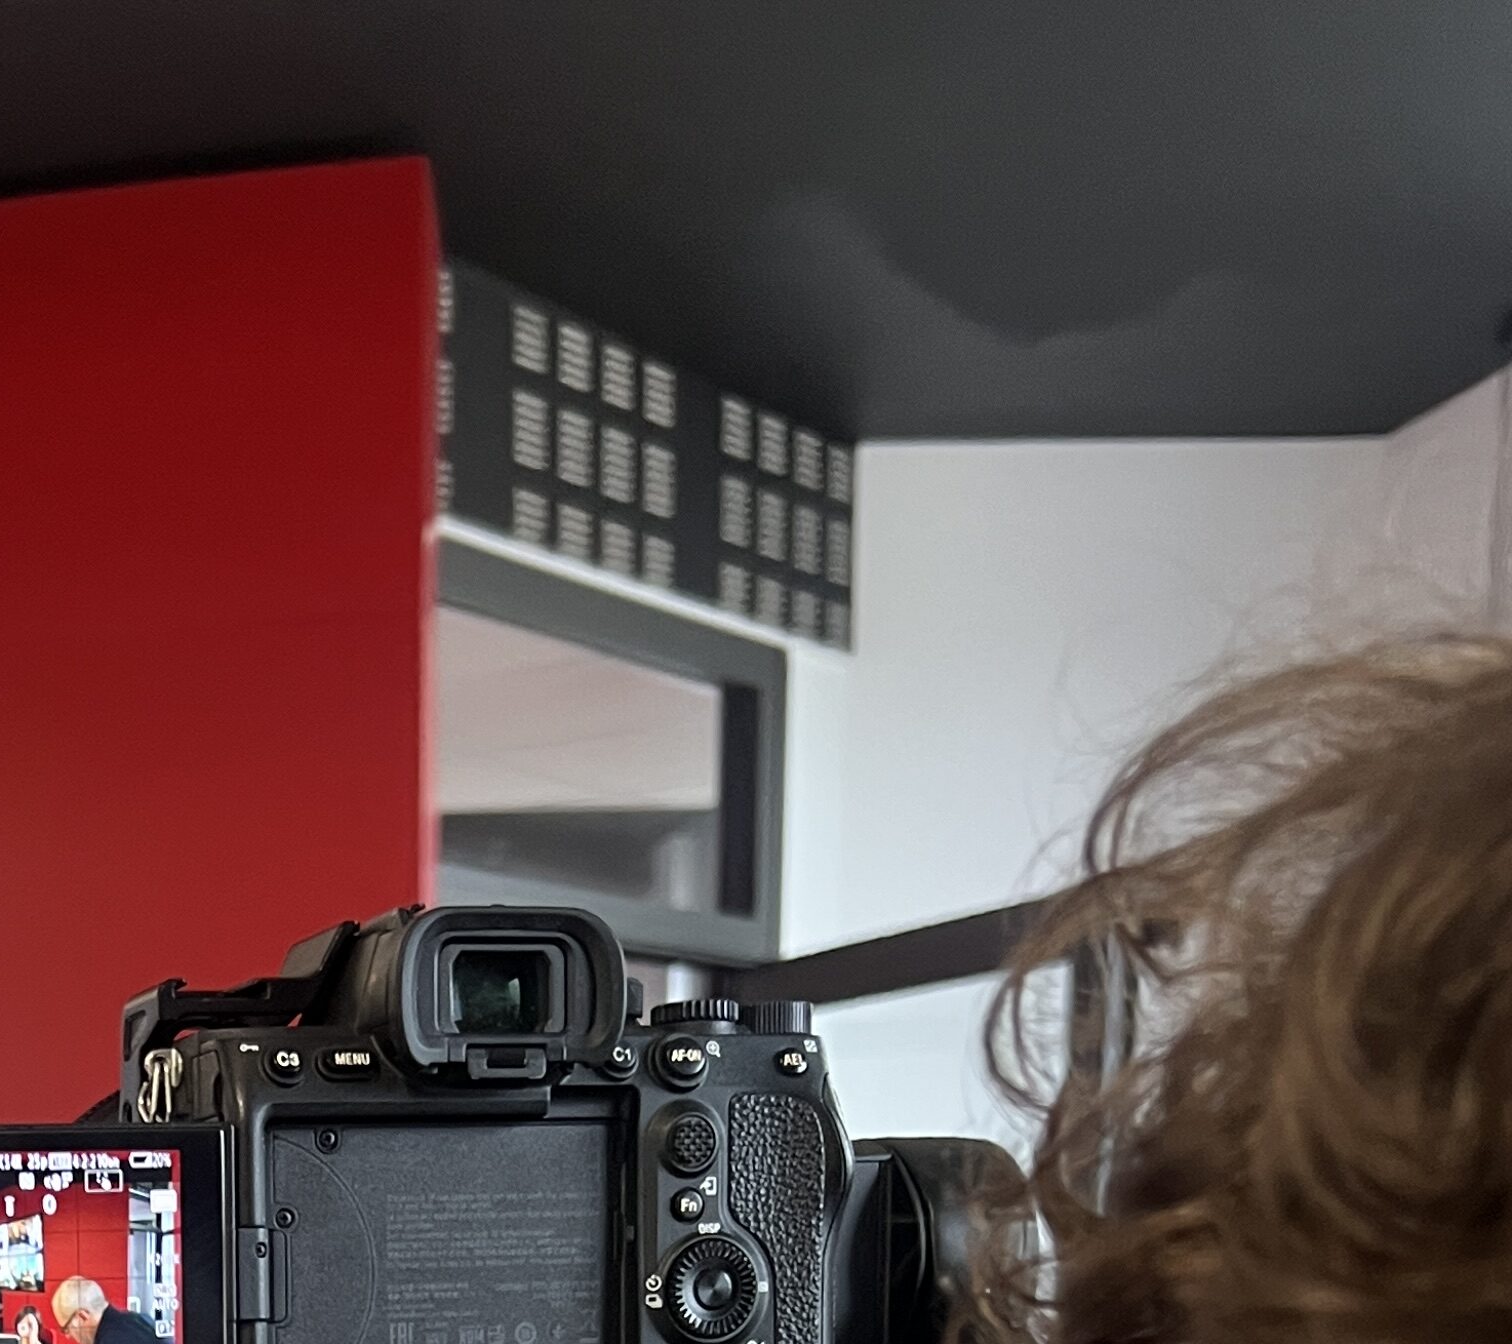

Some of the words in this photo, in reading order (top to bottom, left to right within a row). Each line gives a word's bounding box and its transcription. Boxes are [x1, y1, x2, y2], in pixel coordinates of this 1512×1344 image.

[276, 1050, 301, 1068] C3
[334, 1052, 371, 1066] MENU
[612, 1046, 632, 1062] C1
[680, 1198, 699, 1213] Fn
[698, 1223, 721, 1235] DISP
